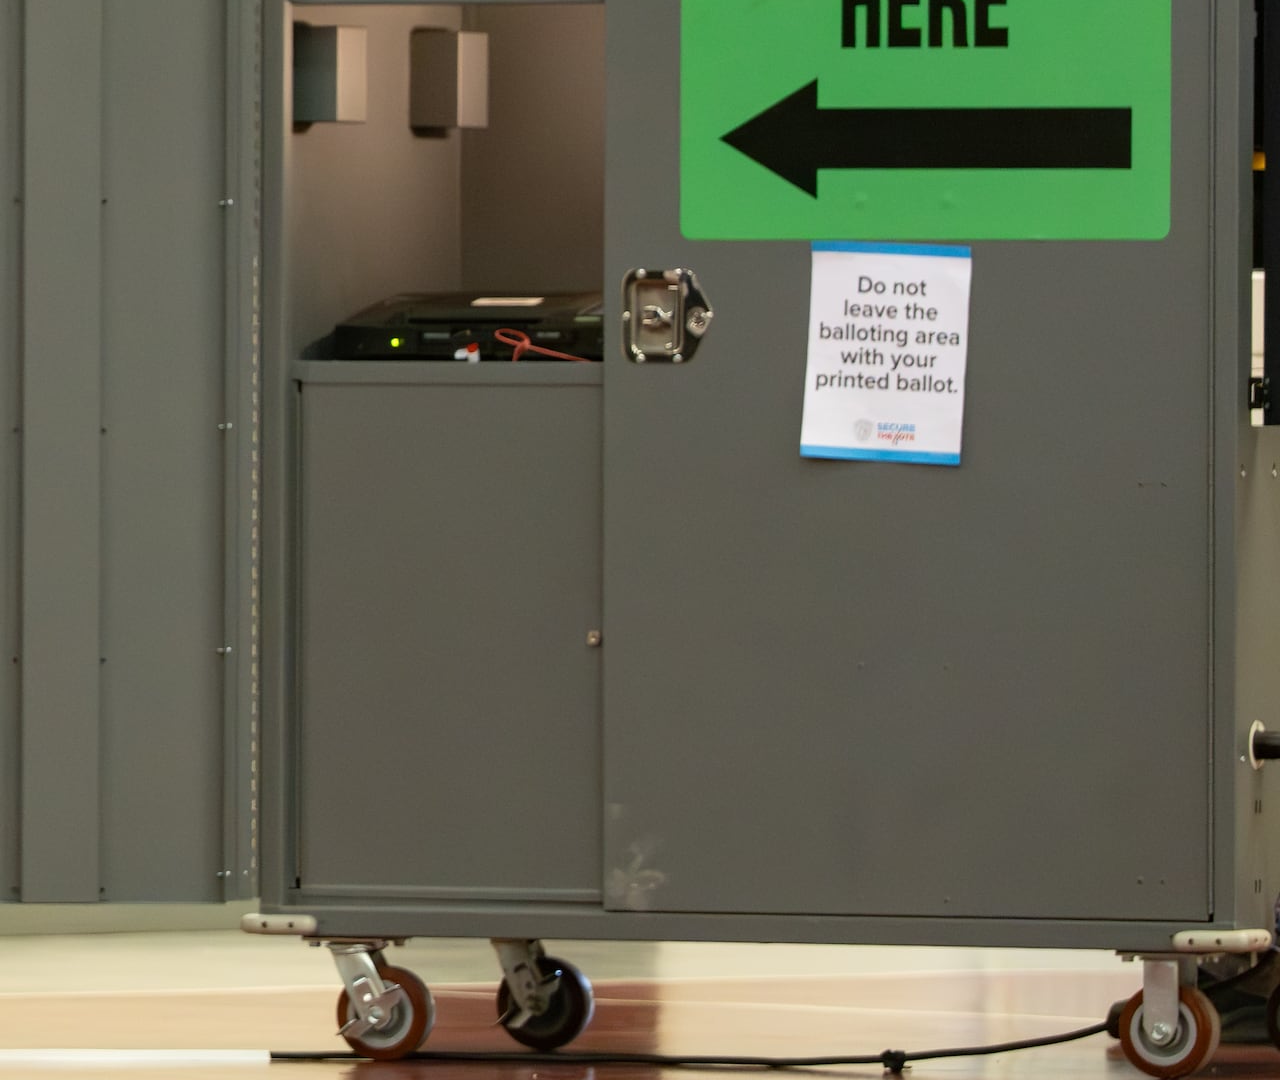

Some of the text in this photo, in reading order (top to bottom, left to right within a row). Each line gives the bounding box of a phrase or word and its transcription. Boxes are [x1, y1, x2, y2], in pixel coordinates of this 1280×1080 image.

[857, 276, 927, 296] Do not
[844, 299, 938, 321] leave the
[819, 321, 960, 347] balloting area
[841, 347, 937, 371] with your
[815, 370, 958, 394] printed ballot.
